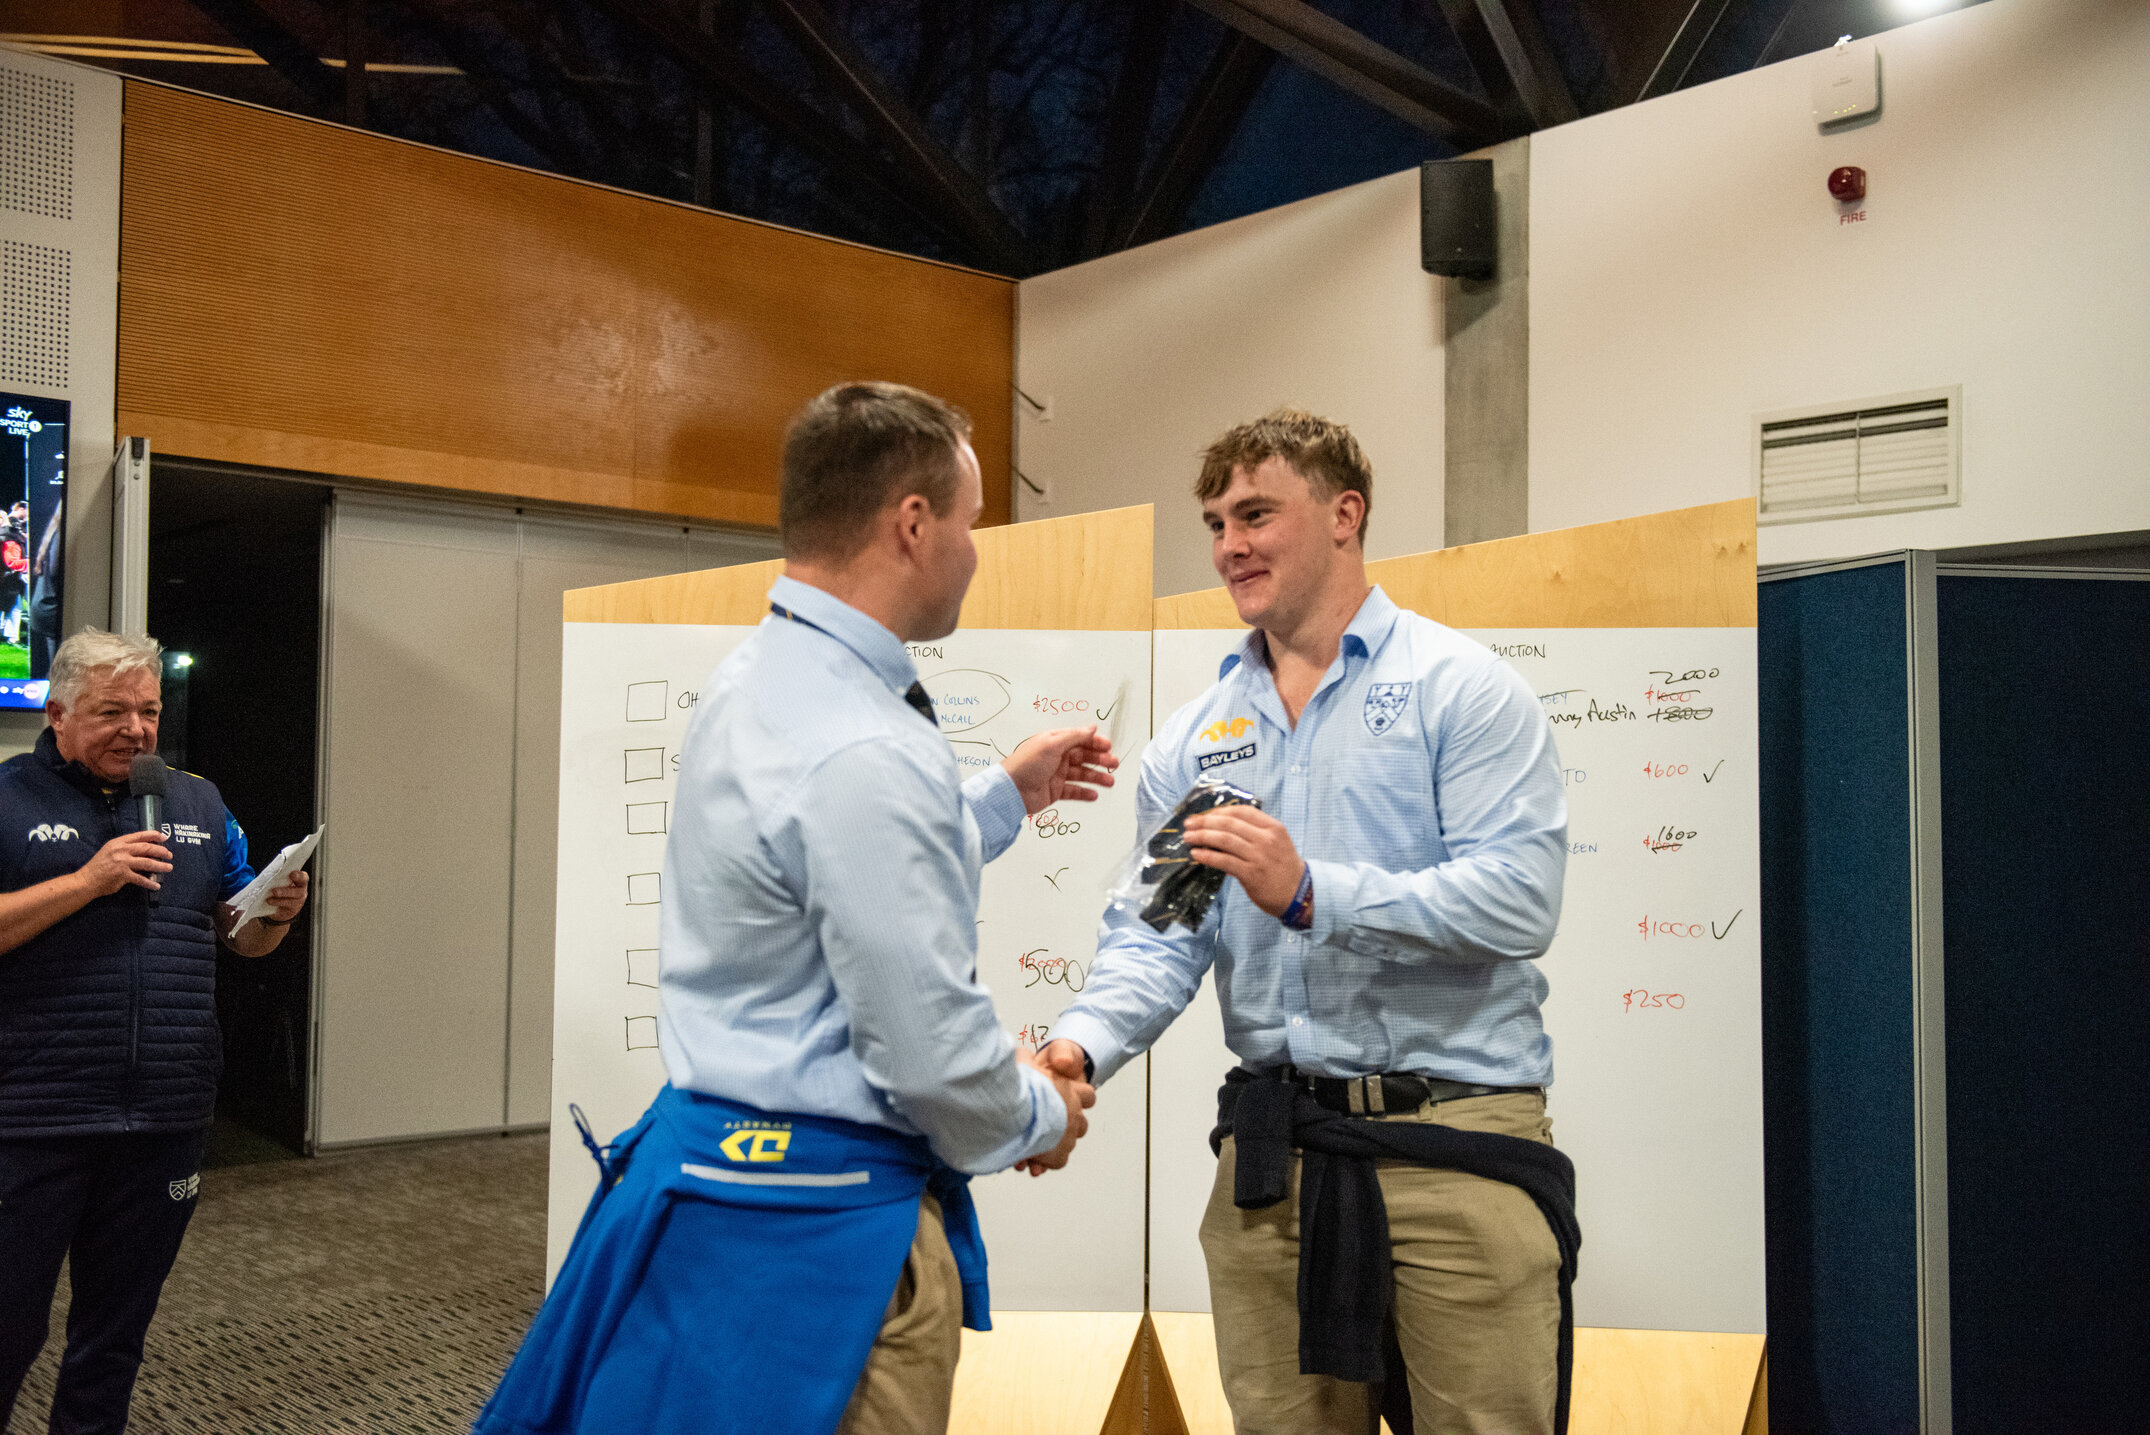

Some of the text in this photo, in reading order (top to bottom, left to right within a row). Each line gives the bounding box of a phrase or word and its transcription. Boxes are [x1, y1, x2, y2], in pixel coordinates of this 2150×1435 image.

[1840, 211, 1867, 225] FIRE
[7, 405, 33, 421] sky
[0, 419, 28, 428] SPORT
[8, 427, 29, 437] LIVE
[944, 693, 980, 705] COLLINS
[1033, 694, 1090, 716] $2500
[1588, 698, 1637, 722] Austin
[1200, 745, 1255, 769] BAYLEYS
[1643, 761, 1689, 780] $600
[173, 823, 198, 831] WHARE
[1658, 825, 1697, 842] 1600
[1638, 914, 1706, 941] $1000
[1623, 988, 1686, 1014] $250
